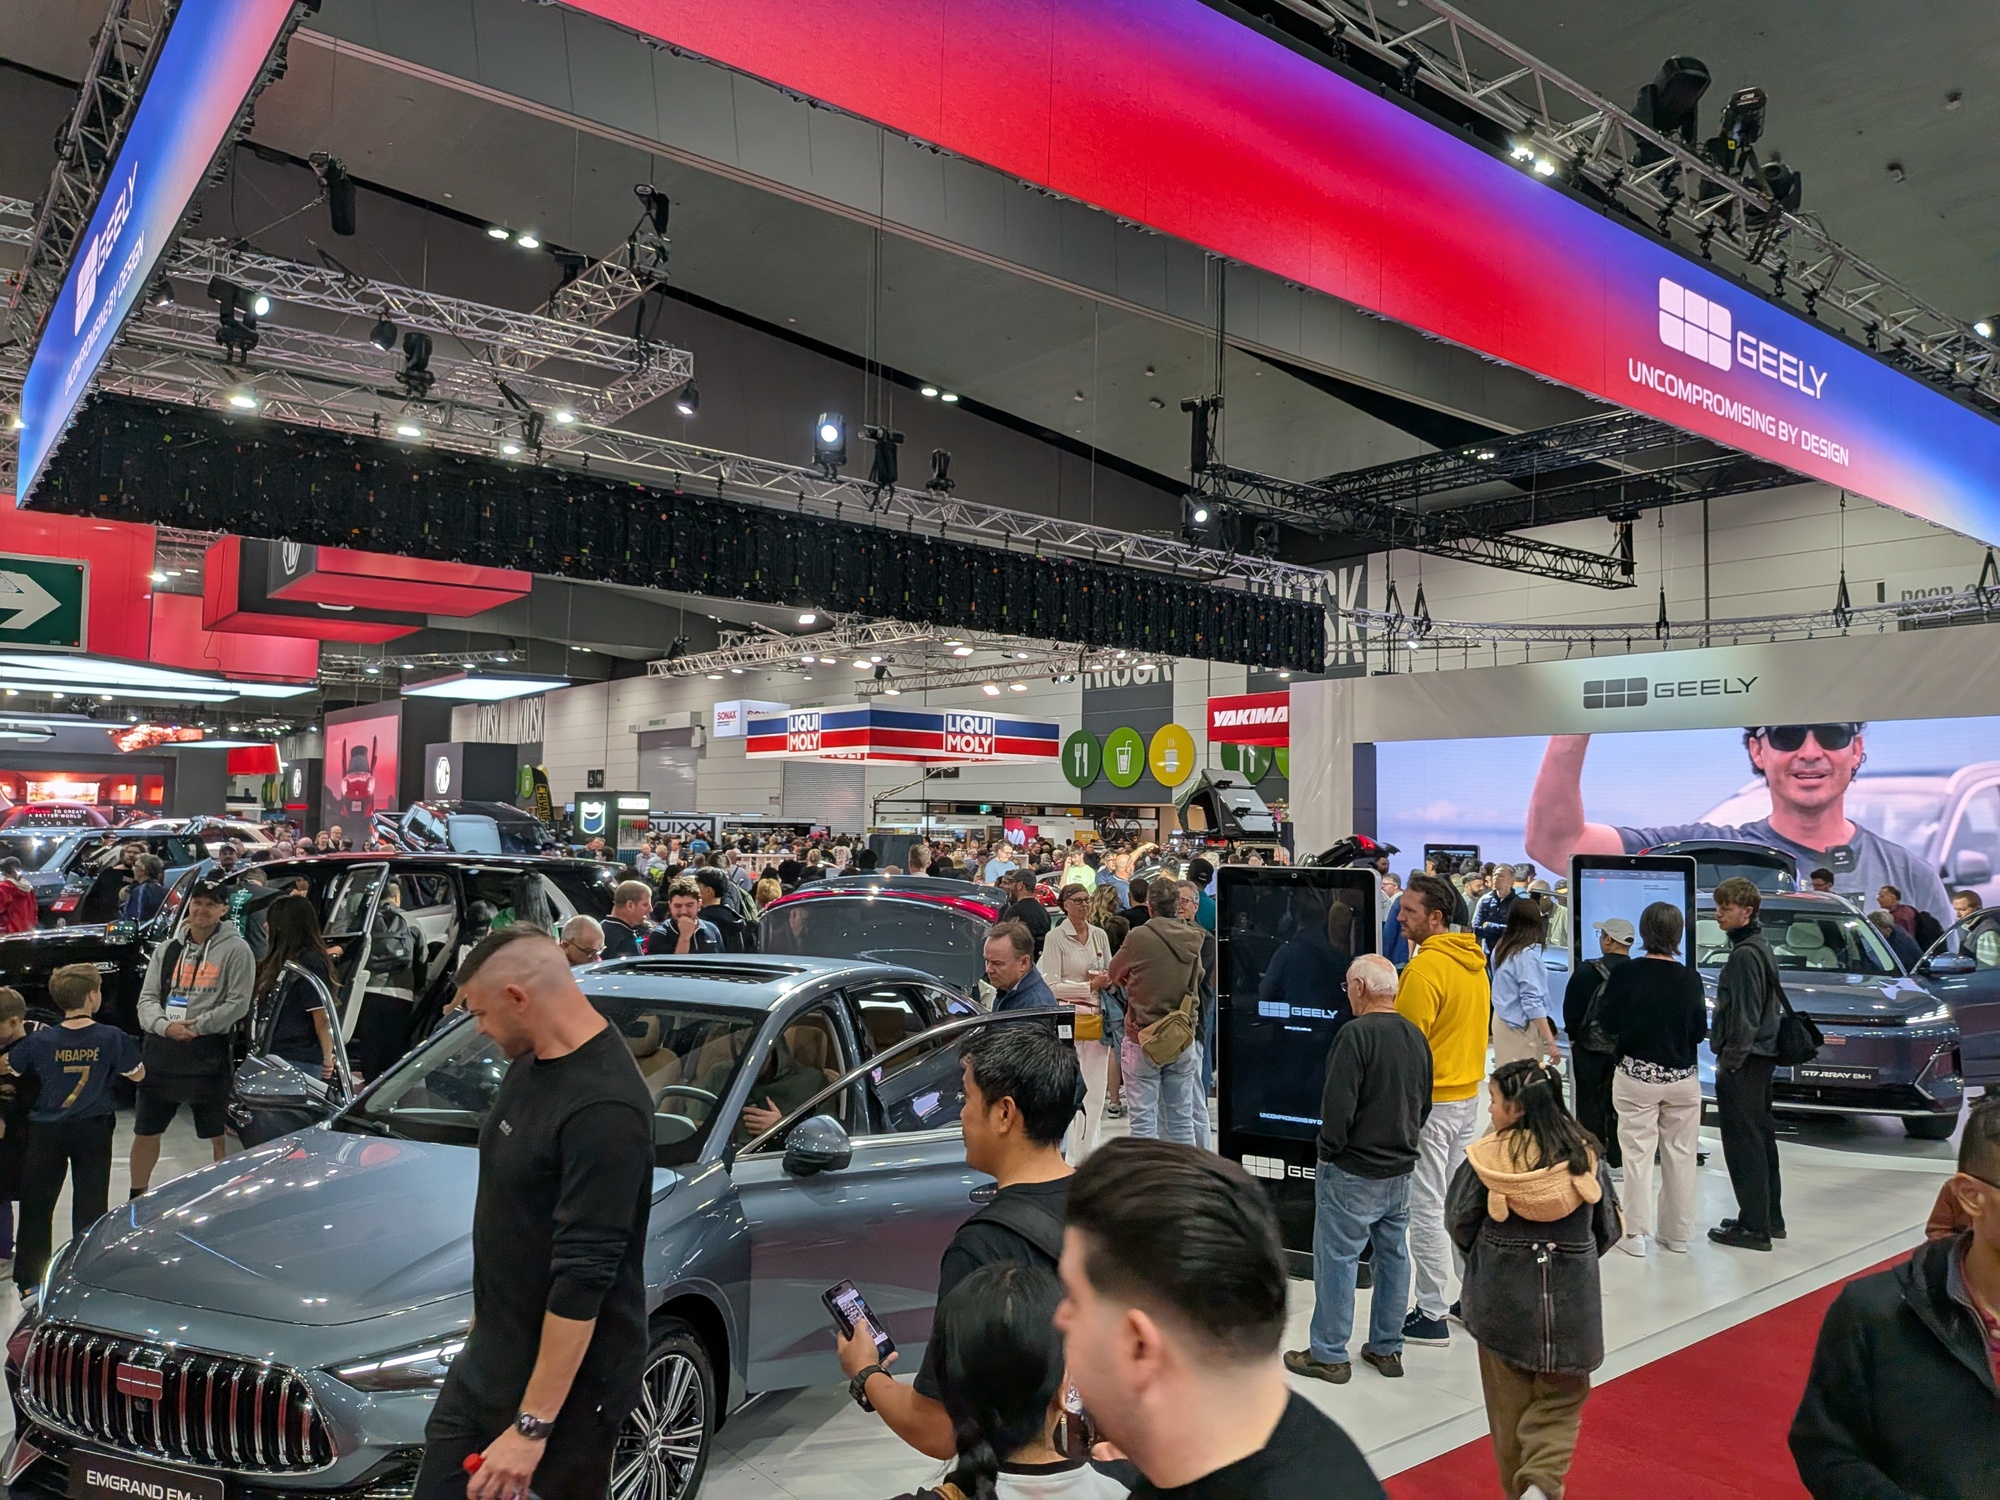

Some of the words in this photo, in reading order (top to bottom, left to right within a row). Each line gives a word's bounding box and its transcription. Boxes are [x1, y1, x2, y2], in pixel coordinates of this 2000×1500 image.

[97, 161, 138, 276] GEELY
[64, 306, 109, 396] UNCOMPROMISING
[118, 230, 145, 299] DESIGN
[1737, 330, 1828, 399] GEELY
[1628, 357, 1776, 437] UNCOMPROMISING
[1778, 420, 1799, 446] BY
[1801, 429, 1849, 467] DESIGN
[1654, 676, 1759, 698] GEELY
[519, 696, 546, 744] KIOSK
[717, 709, 737, 721] SONAX
[790, 713, 819, 733] LIQUI
[947, 714, 992, 735] LIQUI
[1213, 705, 1289, 727] YAKIMA
[790, 732, 819, 751] MOLY
[946, 734, 992, 753] MOLY
[536, 784, 551, 822] CHIVAL
[169, 1013, 181, 1021] VIP
[1291, 1006, 1338, 1019] GEELY
[55, 1046, 100, 1062] MBAPPÉ
[1801, 1070, 1852, 1079] STARRAY
[61, 1065, 91, 1108] 7
[86, 1469, 164, 1500] EMGRAND
